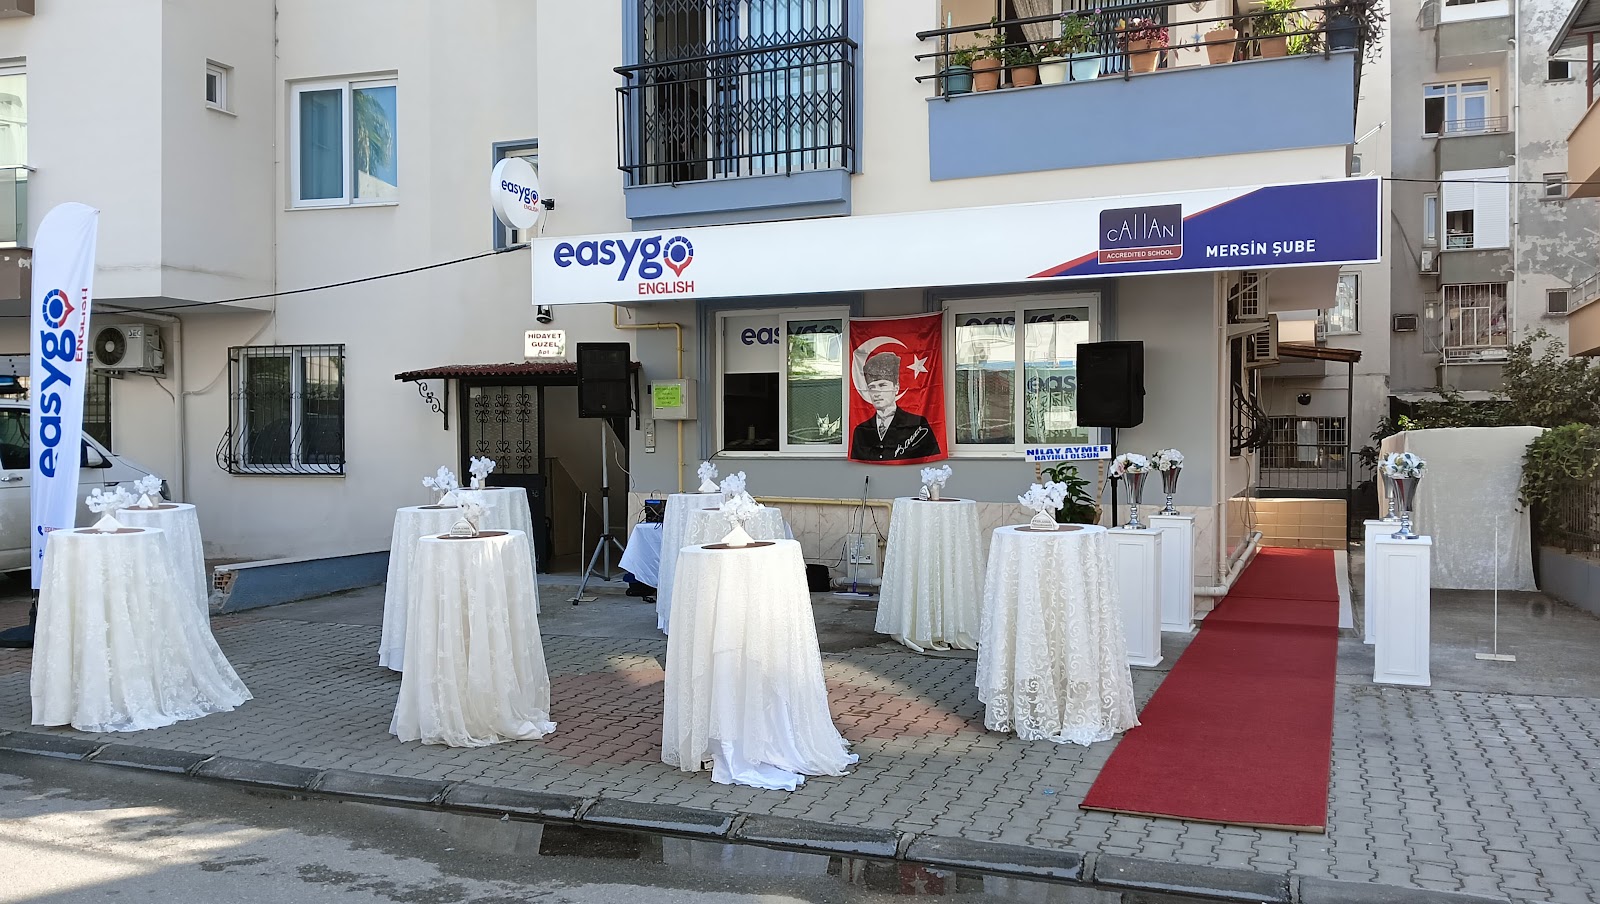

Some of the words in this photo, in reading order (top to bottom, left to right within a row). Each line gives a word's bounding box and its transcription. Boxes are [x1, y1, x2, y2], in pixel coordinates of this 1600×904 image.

[501, 180, 539, 206] easygo
[553, 235, 694, 281] easygo
[1106, 251, 1146, 259] ACCREDITED
[1147, 249, 1173, 257] SCHOOL
[1206, 240, 1267, 258] MERSİN
[1272, 239, 1316, 257] ŞUBE
[638, 281, 695, 294] ENGLISH
[76, 288, 88, 362] ENGLISH
[39, 288, 75, 477] easygo
[1026, 448, 1061, 456] NİLAY
[1064, 445, 1108, 453] AYMER
